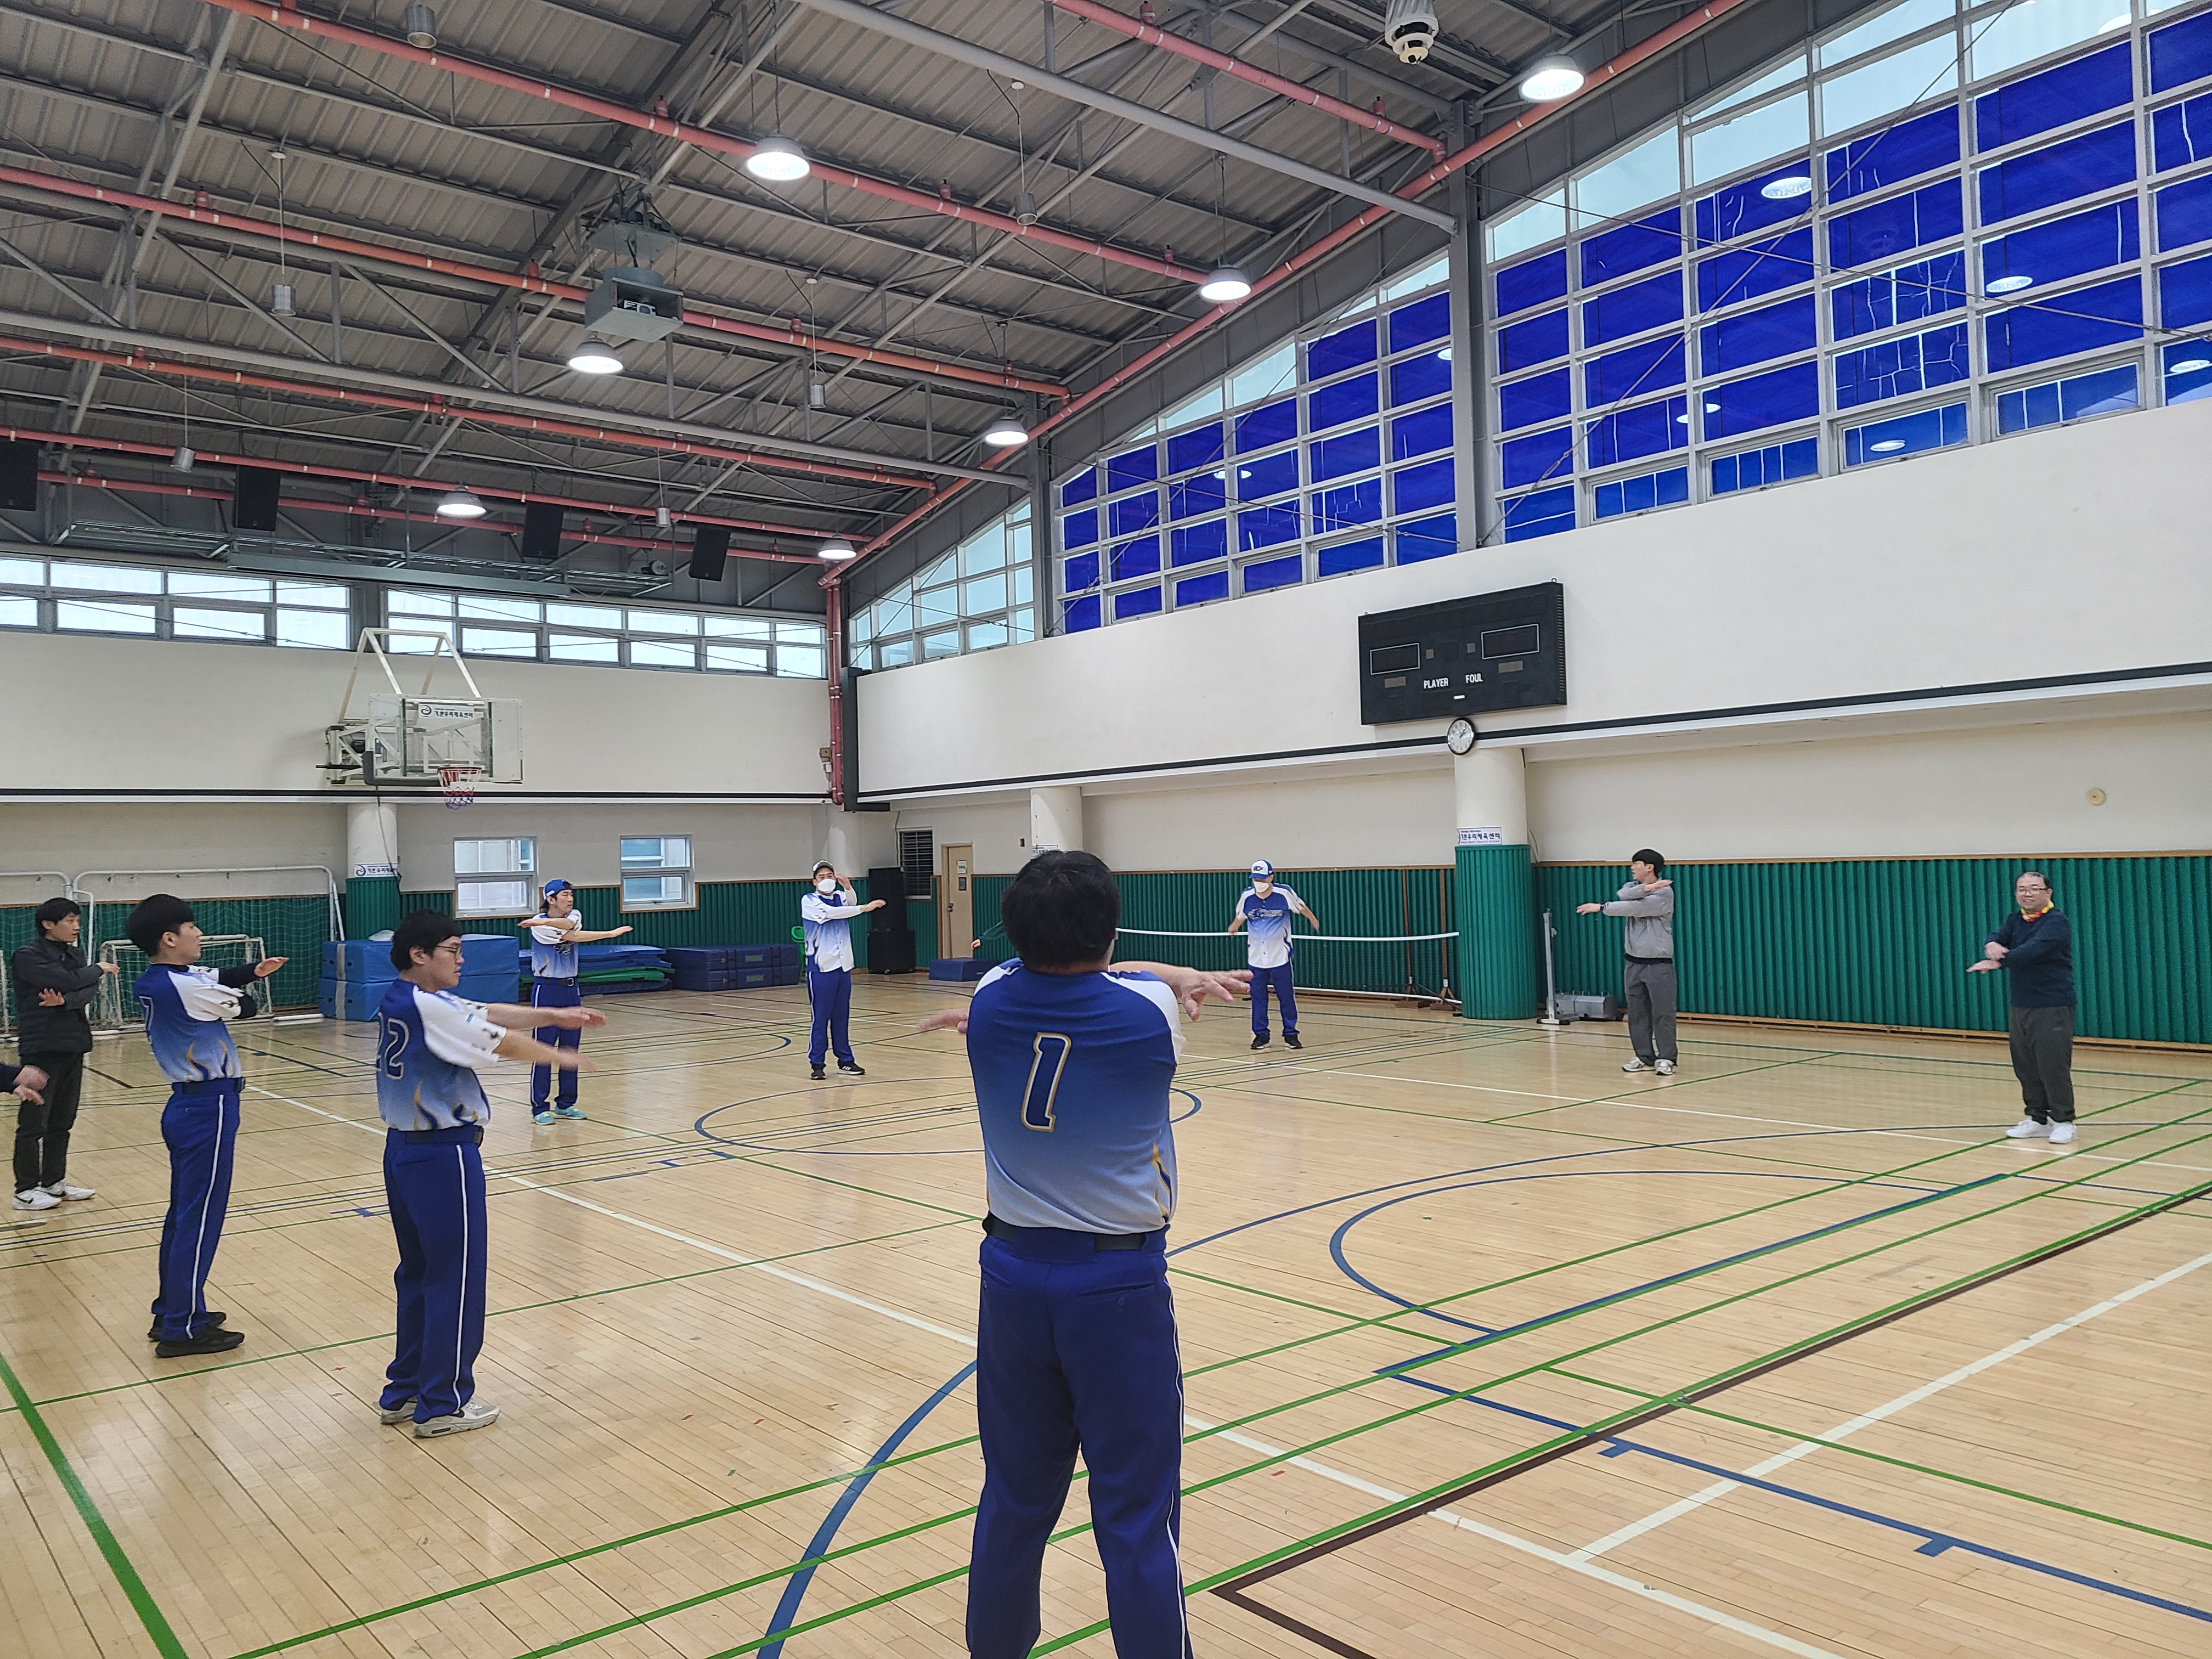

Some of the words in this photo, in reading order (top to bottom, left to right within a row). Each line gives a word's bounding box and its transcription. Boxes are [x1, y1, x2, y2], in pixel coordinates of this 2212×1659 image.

[1424, 678, 1449, 689] PLAYER
[1465, 673, 1483, 684] FOUL
[1021, 1032, 1071, 1132] 1
